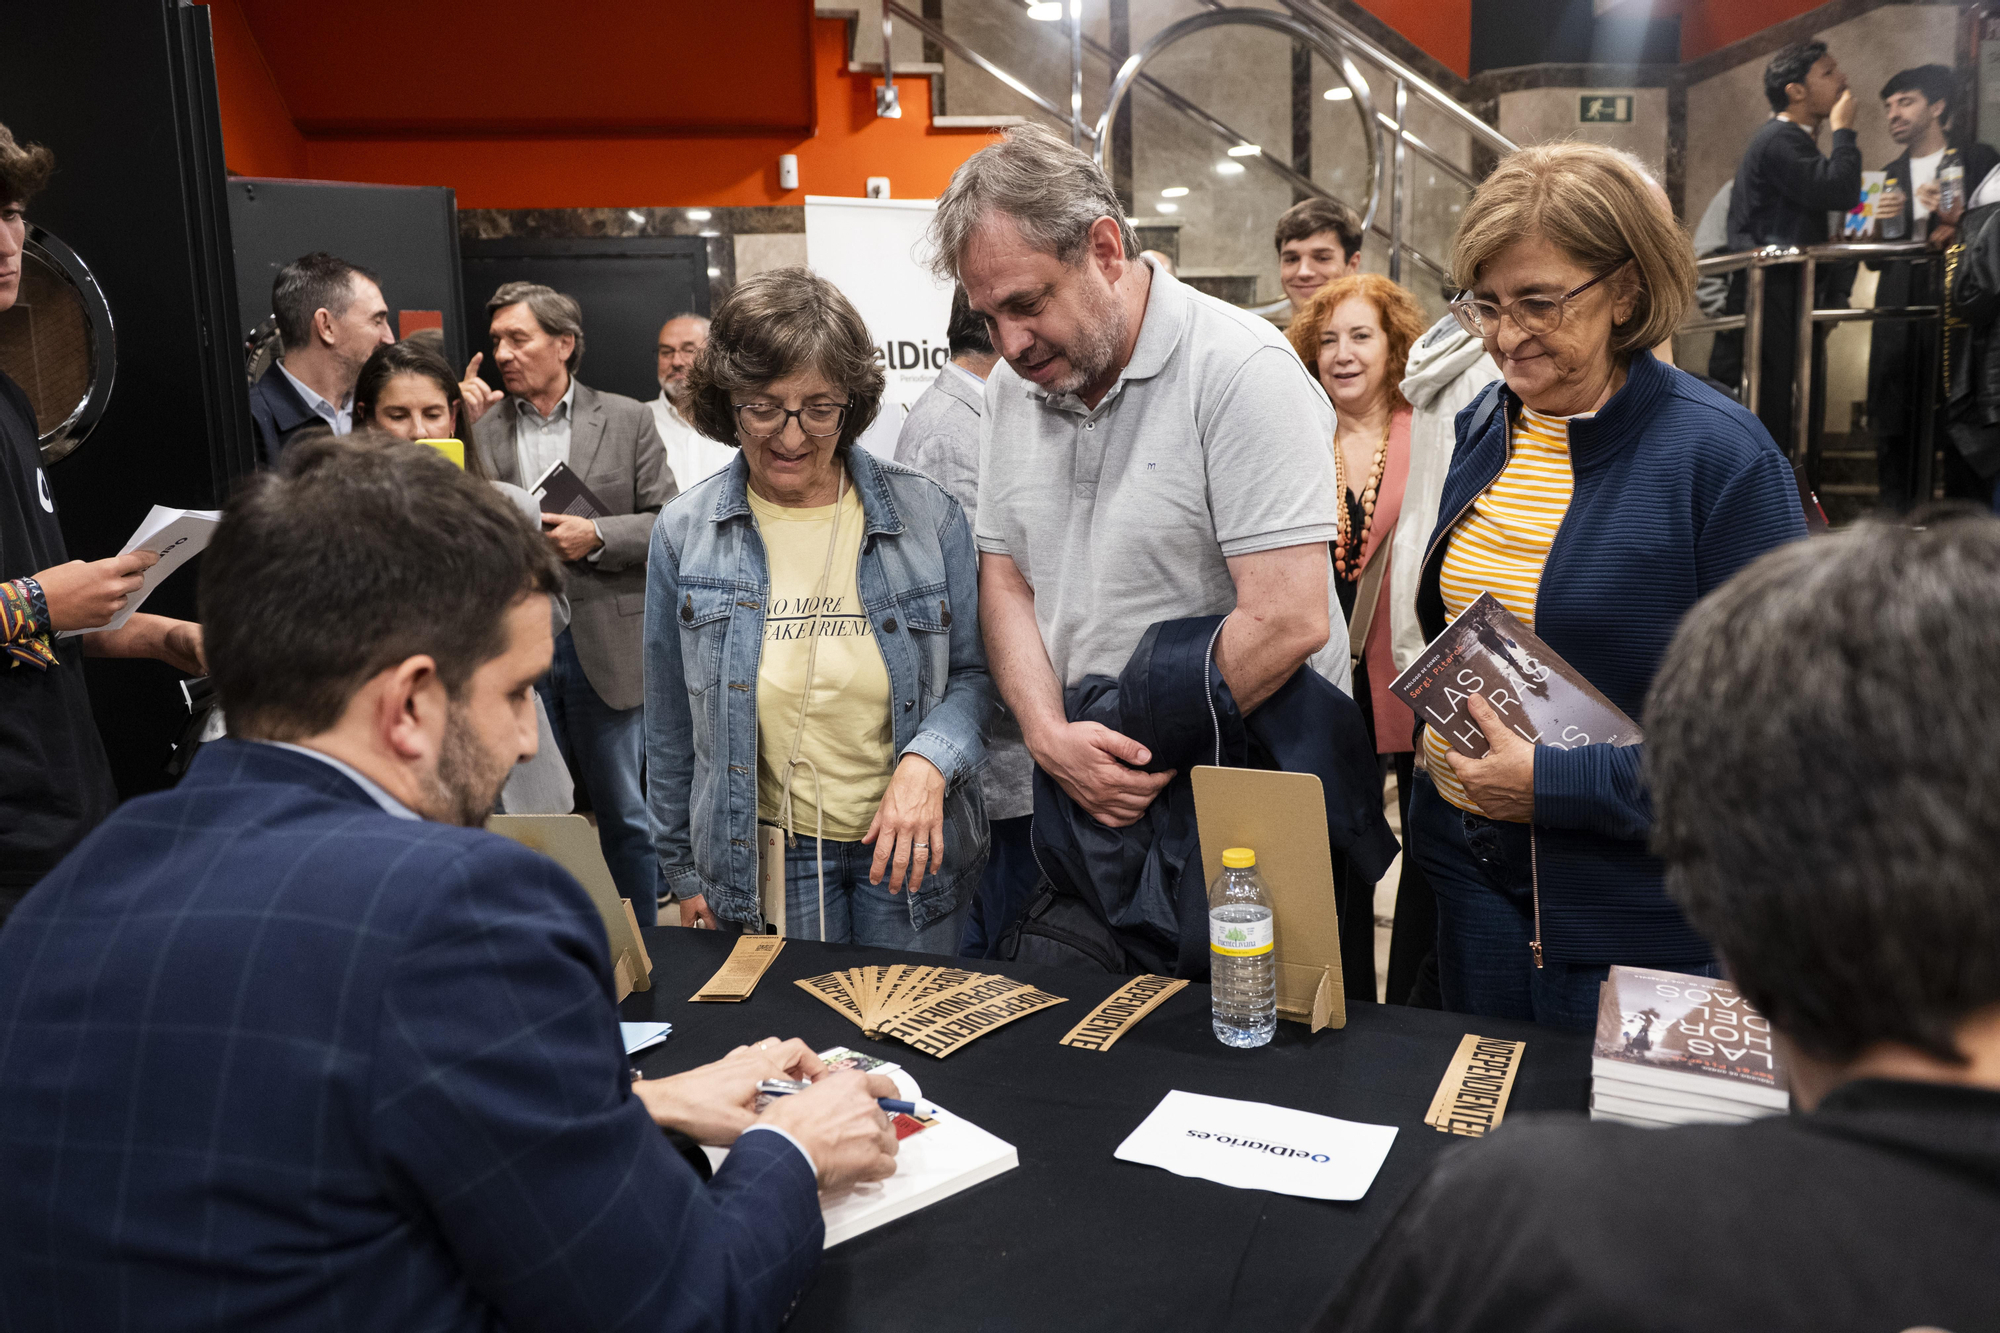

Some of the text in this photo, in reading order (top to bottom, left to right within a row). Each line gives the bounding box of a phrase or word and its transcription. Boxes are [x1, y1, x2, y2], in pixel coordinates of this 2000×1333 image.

[791, 596, 845, 615] MORE
[1409, 675, 1435, 701] Sergi
[1425, 668, 1485, 725] LAS
[1453, 656, 1551, 750] HRAS
[911, 990, 1061, 1057] INDEPENDIENTE
[1067, 974, 1178, 1051] INDEPENDIENTE
[1620, 1011, 1772, 1050] HORAS
[1688, 1004, 1771, 1033] DEL
[1687, 1038, 1773, 1070] LAS
[1448, 1036, 1519, 1133] INDEPENDIENTE
[1186, 1129, 1310, 1158] elDiario.es
